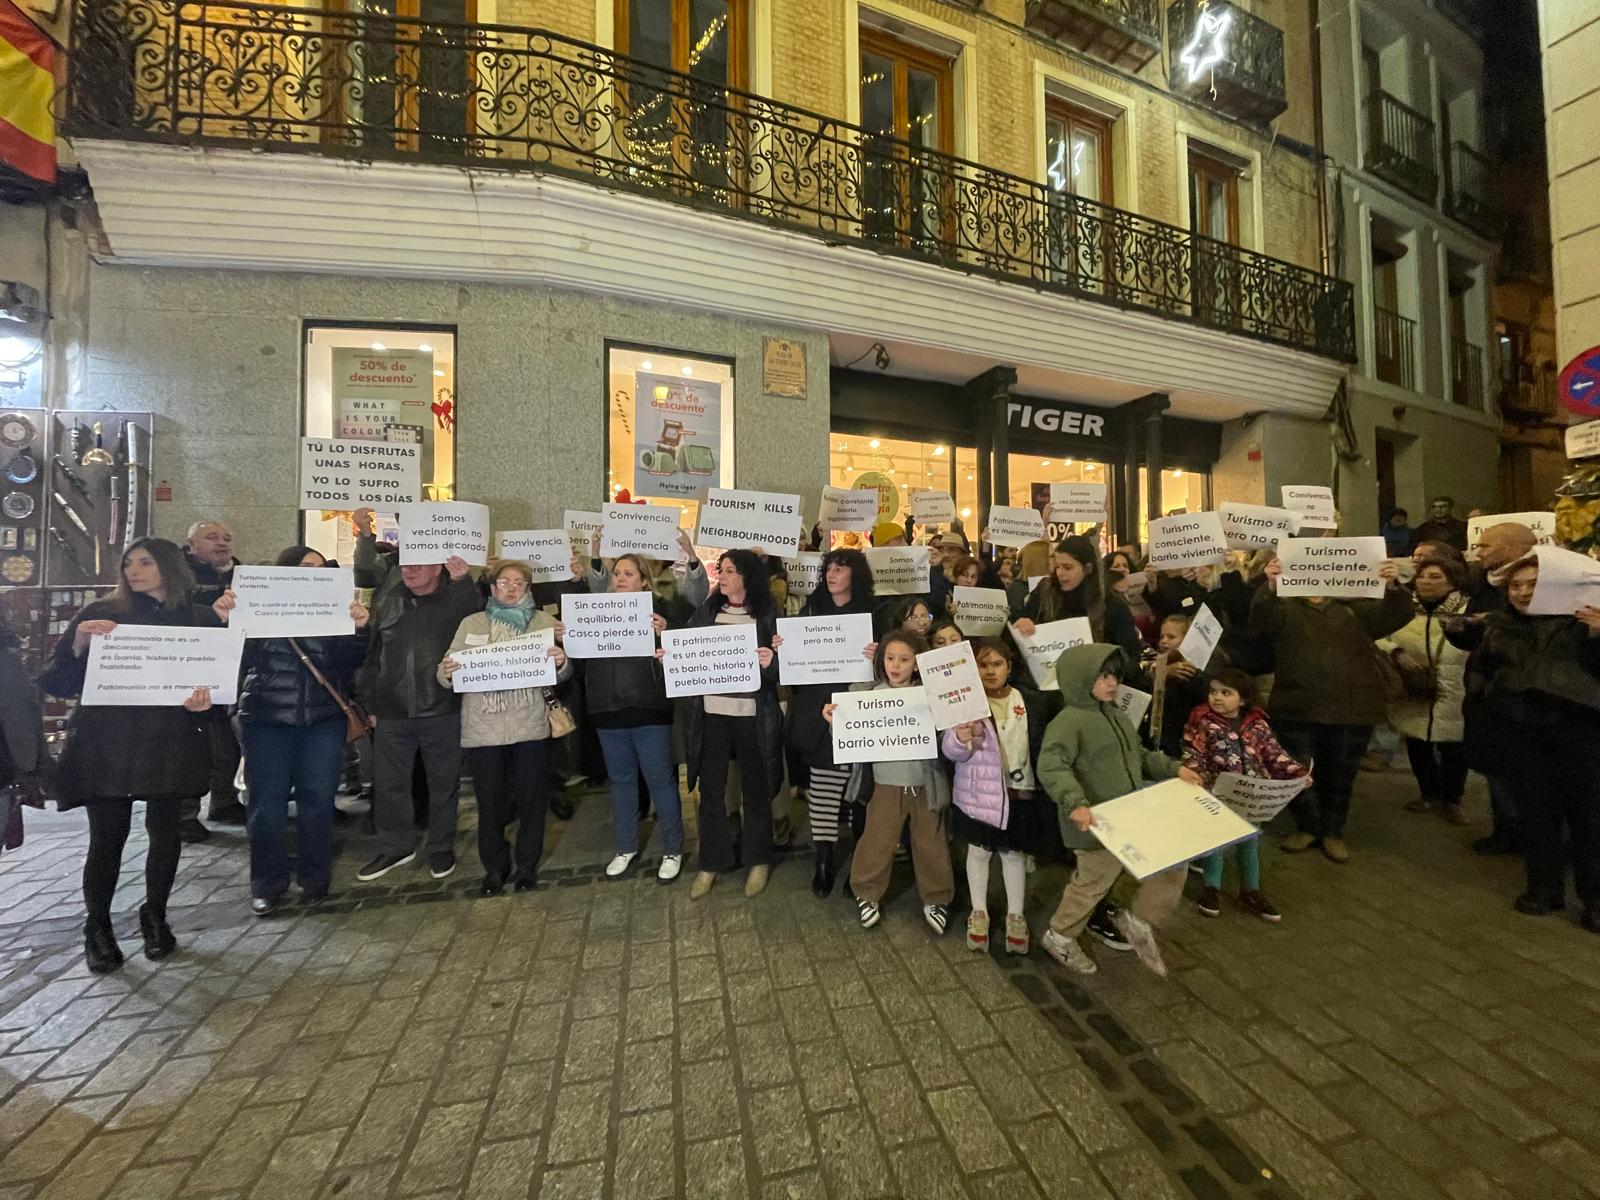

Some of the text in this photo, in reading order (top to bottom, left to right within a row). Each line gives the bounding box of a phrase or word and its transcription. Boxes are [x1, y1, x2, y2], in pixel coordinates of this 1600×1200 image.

[360, 360, 406, 371] 50% de
[686, 393, 699, 403] de
[365, 415, 396, 423] YOUR
[343, 427, 381, 435] COLOU
[329, 444, 345, 453] LO
[351, 445, 416, 457] DISFRUTAS
[315, 459, 404, 472] UNAS HORAS,
[312, 476, 399, 488] YO LO SUFRO
[305, 490, 413, 503] TODOS LOS DÍAS
[709, 498, 793, 514] TOURISM KILLS
[431, 514, 466, 523] Somos
[609, 511, 673, 524] Convivencia,
[993, 517, 1032, 527] Patrimonio
[1227, 513, 1274, 528] Turismo
[411, 527, 482, 538] vecindario, no
[634, 528, 647, 536] no
[1161, 522, 1200, 535] Turismo
[700, 526, 797, 546] NEIGHBOURHOODS
[1250, 535, 1267, 545] no
[405, 541, 486, 552] somos decorado
[611, 539, 669, 551] indiferencia
[1155, 536, 1214, 549] consciente,
[528, 553, 541, 561] no
[1151, 547, 1225, 563] barrio viviente
[1304, 546, 1357, 556] Turismo
[1289, 562, 1372, 573] consciente,
[1281, 577, 1380, 587] barrio viviente
[574, 598, 638, 610] Sin control ni
[577, 614, 638, 625] equilibrio, el
[568, 628, 649, 639] Casco pierde su
[804, 625, 833, 633] Turismo
[672, 634, 746, 647] El patrimonio no
[803, 638, 821, 646] pero
[835, 635, 846, 643] así
[475, 647, 488, 655] un
[491, 642, 544, 653] decorado:
[597, 642, 622, 652] brillo
[186, 655, 216, 663] pueblo
[672, 647, 748, 660] es un decorado:
[470, 660, 503, 669] barrio,
[505, 657, 541, 666] historia
[543, 657, 549, 665] y
[669, 661, 754, 674] es barrio, historia y
[462, 670, 546, 684] pueblo habitado
[674, 674, 751, 688] pueblo habitado
[937, 689, 959, 701] PERO
[960, 686, 972, 695] NO
[857, 698, 905, 710] Turismo
[845, 715, 920, 730] consciente,
[838, 734, 931, 750] barrio viviente
